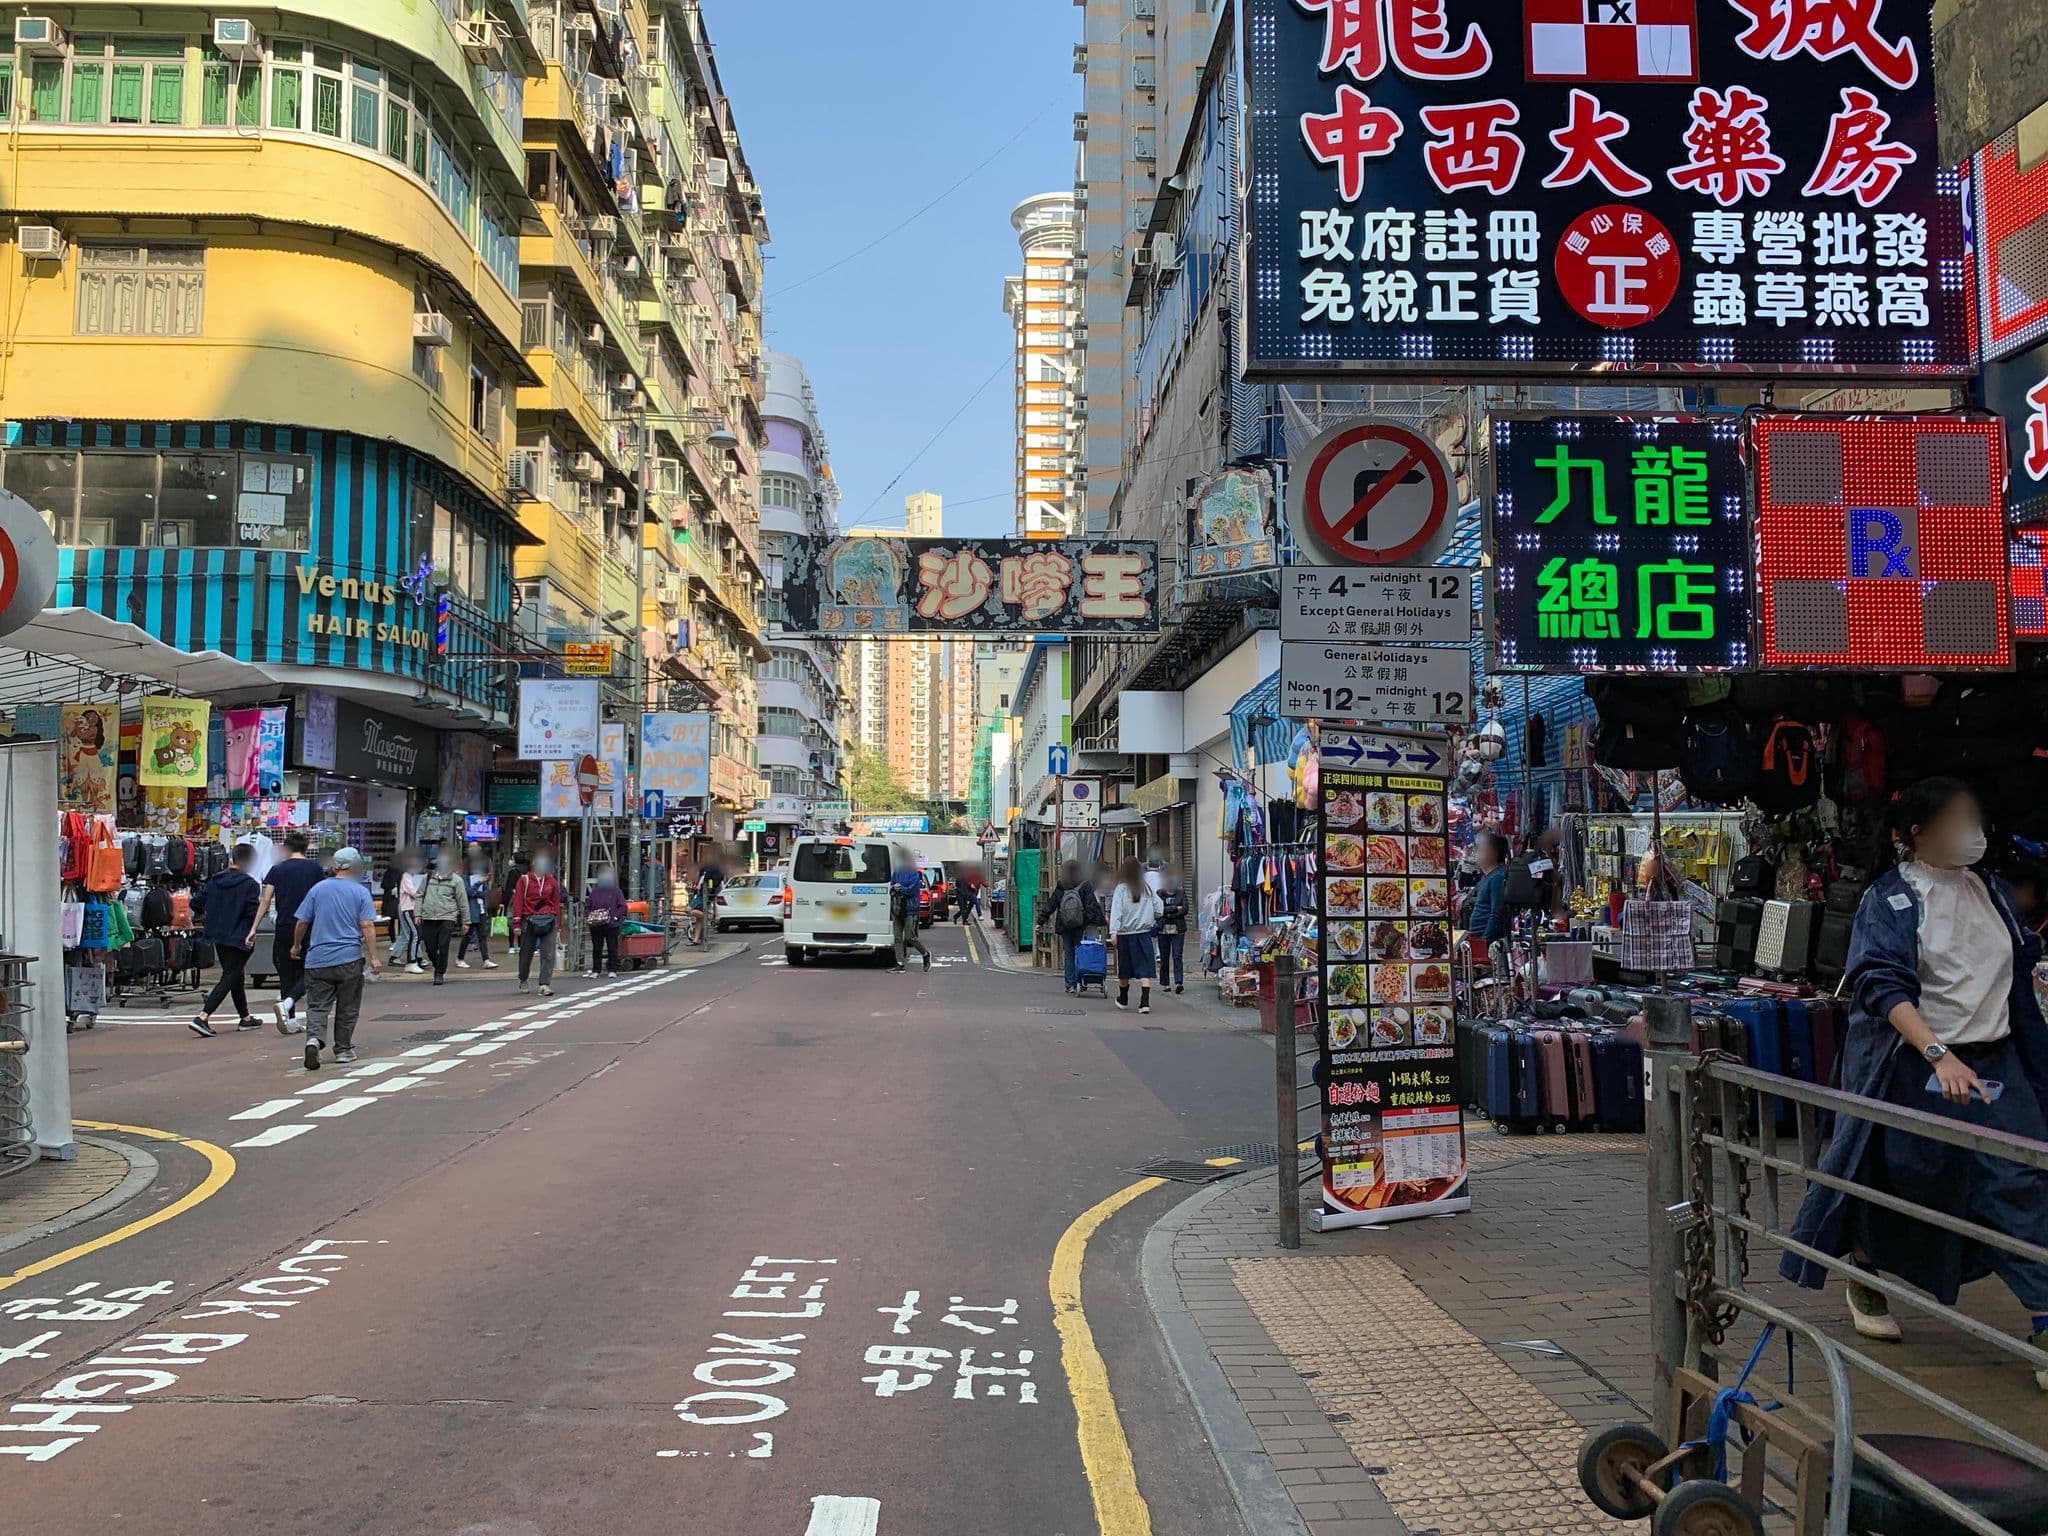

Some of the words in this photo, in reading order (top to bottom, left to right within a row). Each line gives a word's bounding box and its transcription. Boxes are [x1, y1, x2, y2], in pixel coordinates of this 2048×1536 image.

[1299, 83, 1919, 206] 中西大藥房
[1298, 208, 1543, 263] 政府註冊
[1690, 208, 1931, 268] 專營批發
[1586, 255, 1650, 314] 正
[1298, 269, 1543, 326] 免稅正貨
[1690, 270, 1932, 328] 蟲草燕窩
[1533, 443, 1713, 527] 九龍
[240, 523, 271, 541] HK
[295, 565, 396, 606] Venus
[916, 550, 1152, 622] 沙嗲王
[1292, 586, 1323, 601] 下午
[1381, 587, 1412, 602] 午夜
[1298, 573, 1318, 585] pm
[1428, 575, 1460, 600] 12
[1536, 556, 1716, 641] 總店
[1300, 605, 1345, 618] Except
[1346, 606, 1395, 617] General
[1396, 606, 1452, 619] Holidays
[307, 613, 370, 639] HAIR
[376, 622, 429, 651] SALON
[1327, 621, 1424, 636] 公眾假期例外
[1324, 648, 1371, 662] General
[1372, 650, 1429, 664] Holidays
[1344, 666, 1408, 681] 公眾假期
[1287, 680, 1320, 692] Noon
[1375, 685, 1428, 698] midnight
[1432, 691, 1464, 716] 12
[1288, 697, 1318, 712] 中午
[1386, 701, 1417, 716] 午夜
[1327, 733, 1340, 745] GO
[1361, 735, 1377, 746] THIS
[1397, 740, 1412, 750] WAY
[643, 751, 705, 769] AROMA
[651, 771, 698, 790] SHOP
[1086, 803, 1093, 813] 7
[1086, 817, 1098, 827] 12
[1435, 1075, 1450, 1084] $22
[1436, 1094, 1451, 1103] $25
[181, 1239, 388, 1321] LOOK
